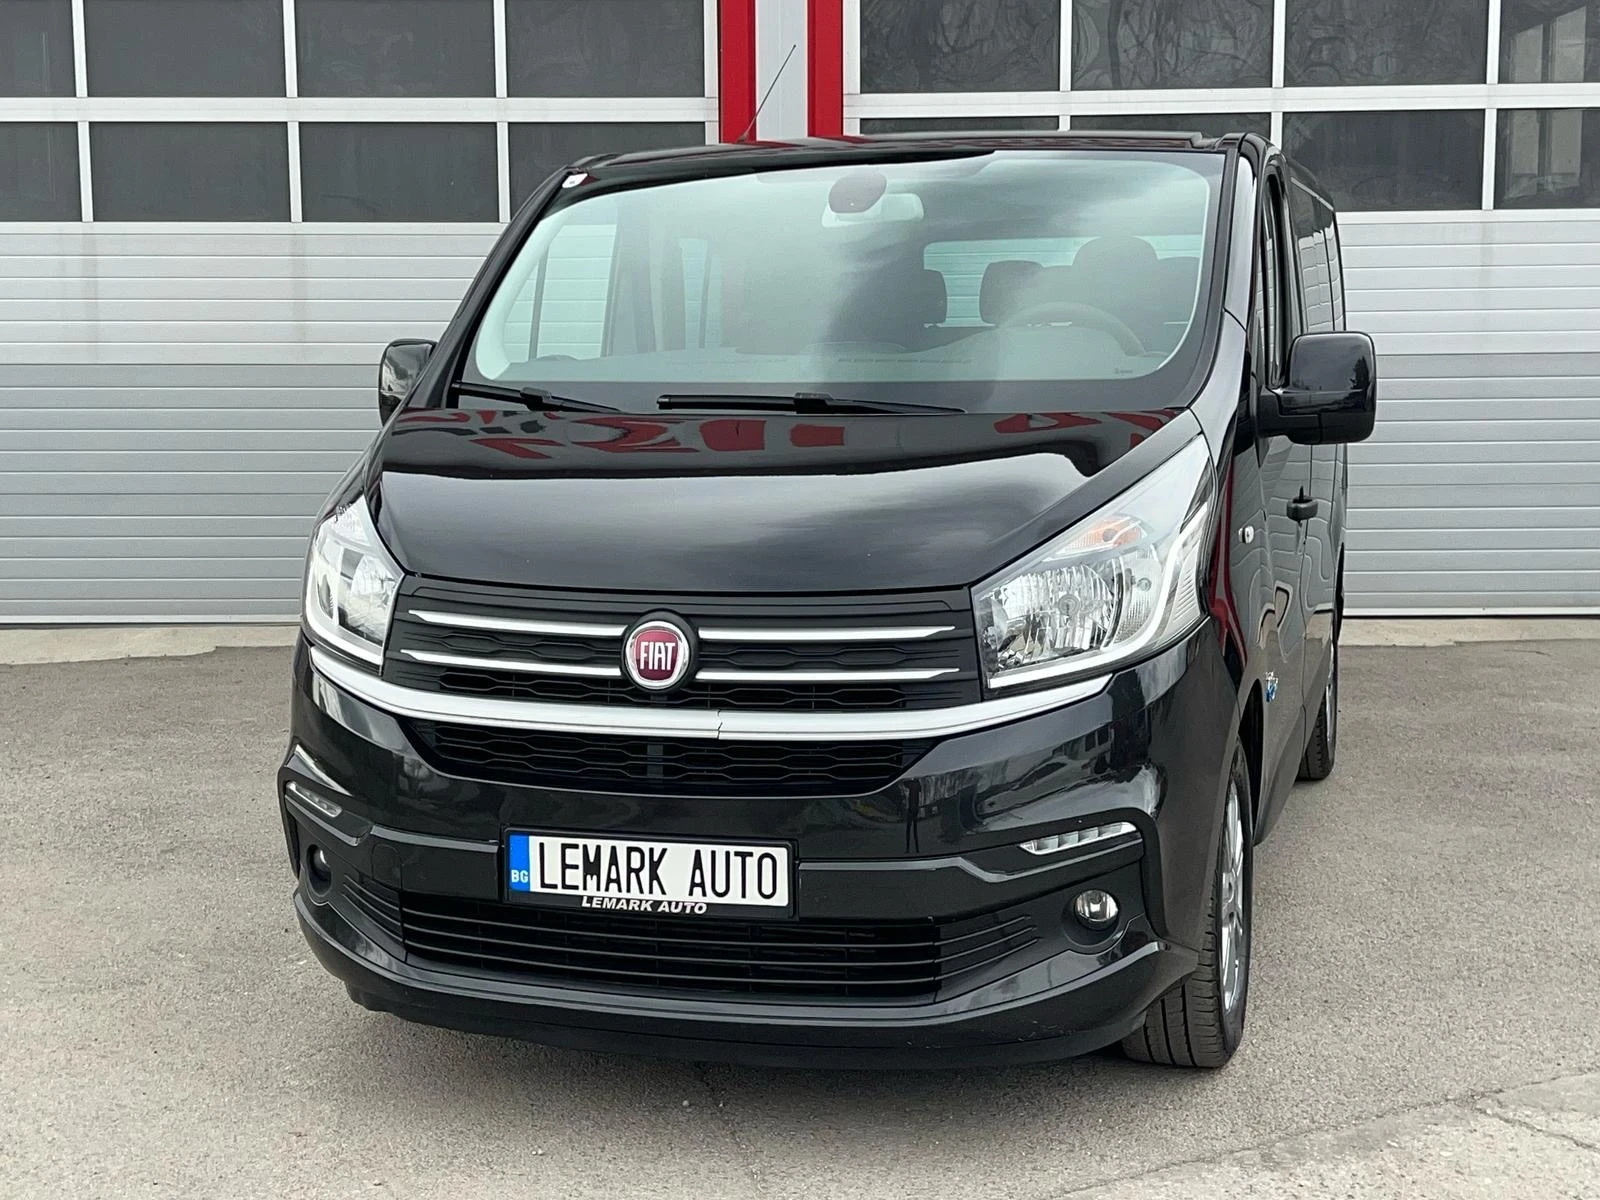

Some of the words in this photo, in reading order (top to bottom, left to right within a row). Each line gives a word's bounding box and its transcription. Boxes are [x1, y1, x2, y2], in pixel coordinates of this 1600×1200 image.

[640, 641, 676, 670] FIAT
[511, 869, 529, 883] BG
[538, 842, 668, 895] LEMARK
[688, 849, 777, 900] AUTO
[581, 895, 653, 912] LEMARK
[657, 901, 707, 914] AUTO
